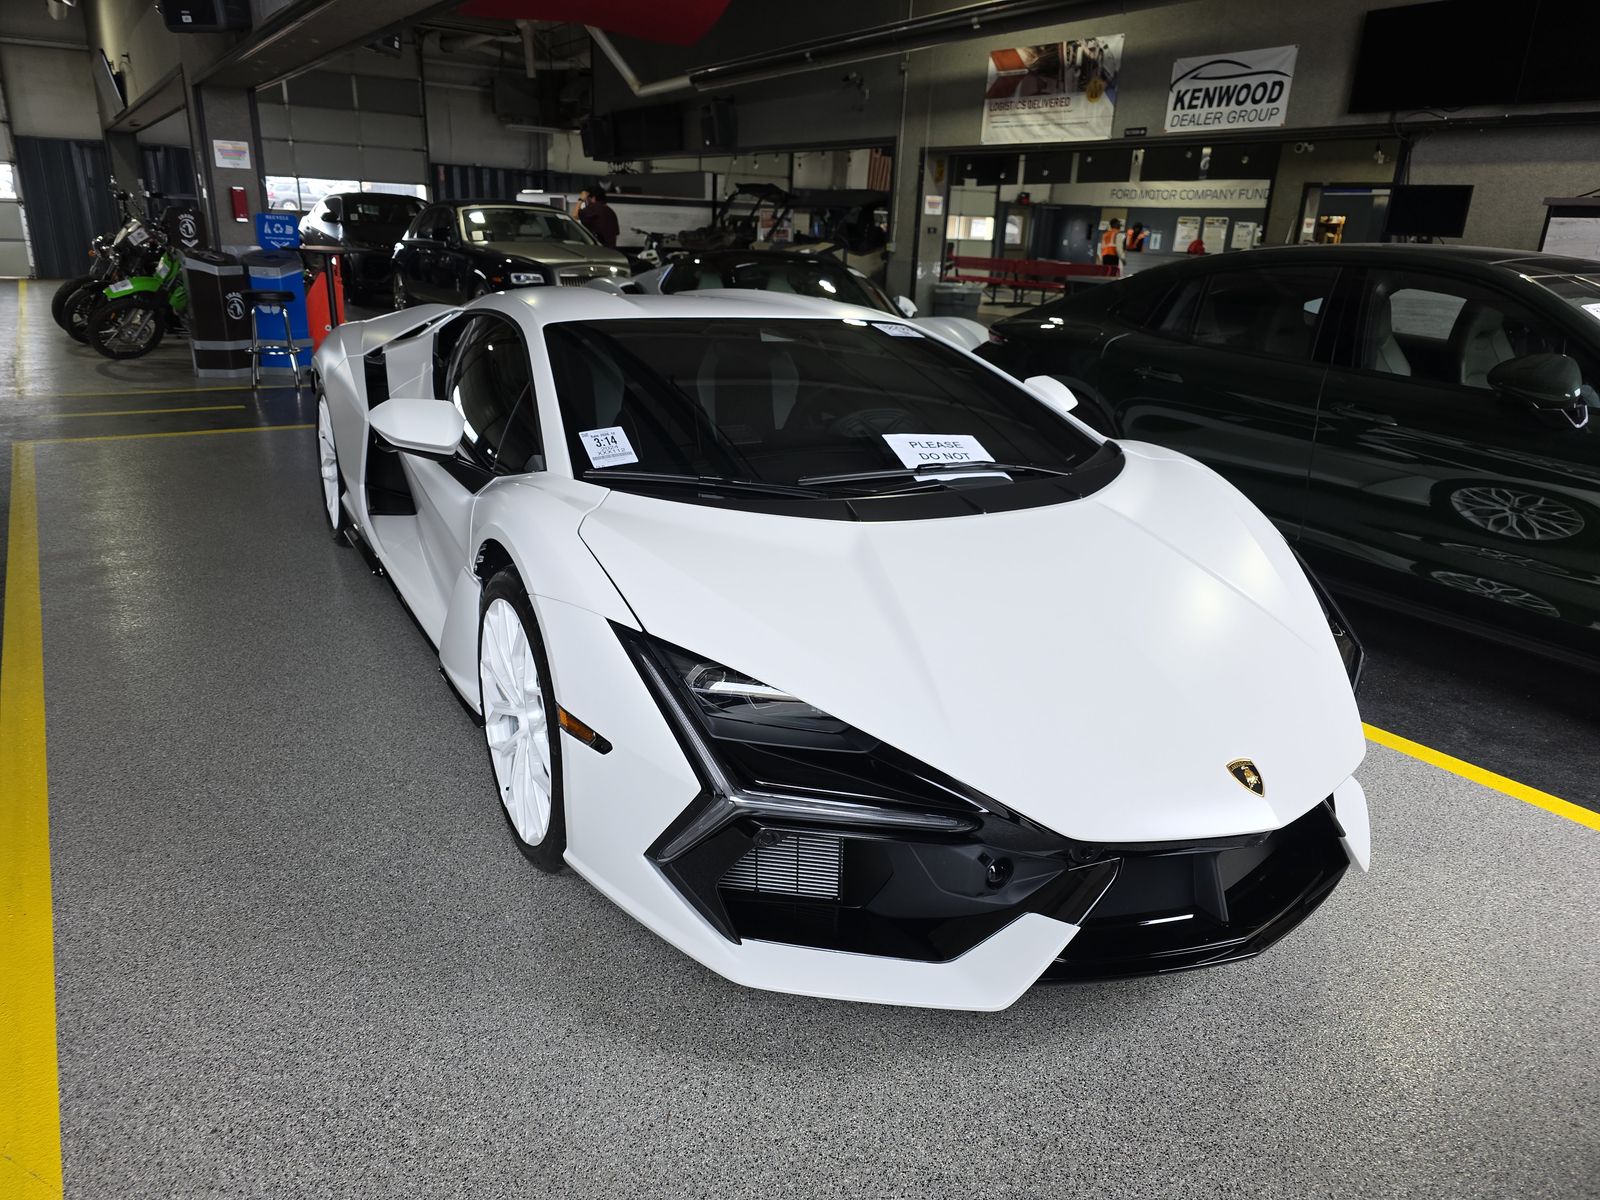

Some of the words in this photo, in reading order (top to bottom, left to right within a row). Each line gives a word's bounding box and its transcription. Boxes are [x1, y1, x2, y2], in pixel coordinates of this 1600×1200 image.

[1173, 80, 1284, 111] KENWOOD
[989, 100, 1026, 112] LOGISTICS
[1027, 97, 1071, 109] DELIVERED
[1170, 111, 1223, 127] DEALER
[1226, 107, 1280, 124] GROUP
[1110, 188, 1137, 200] FORD
[1139, 188, 1177, 200] MOTOR
[1179, 188, 1236, 200] COMPANY
[594, 435, 618, 447] 3:14
[918, 452, 940, 460] DO
[942, 452, 971, 460] NOT
